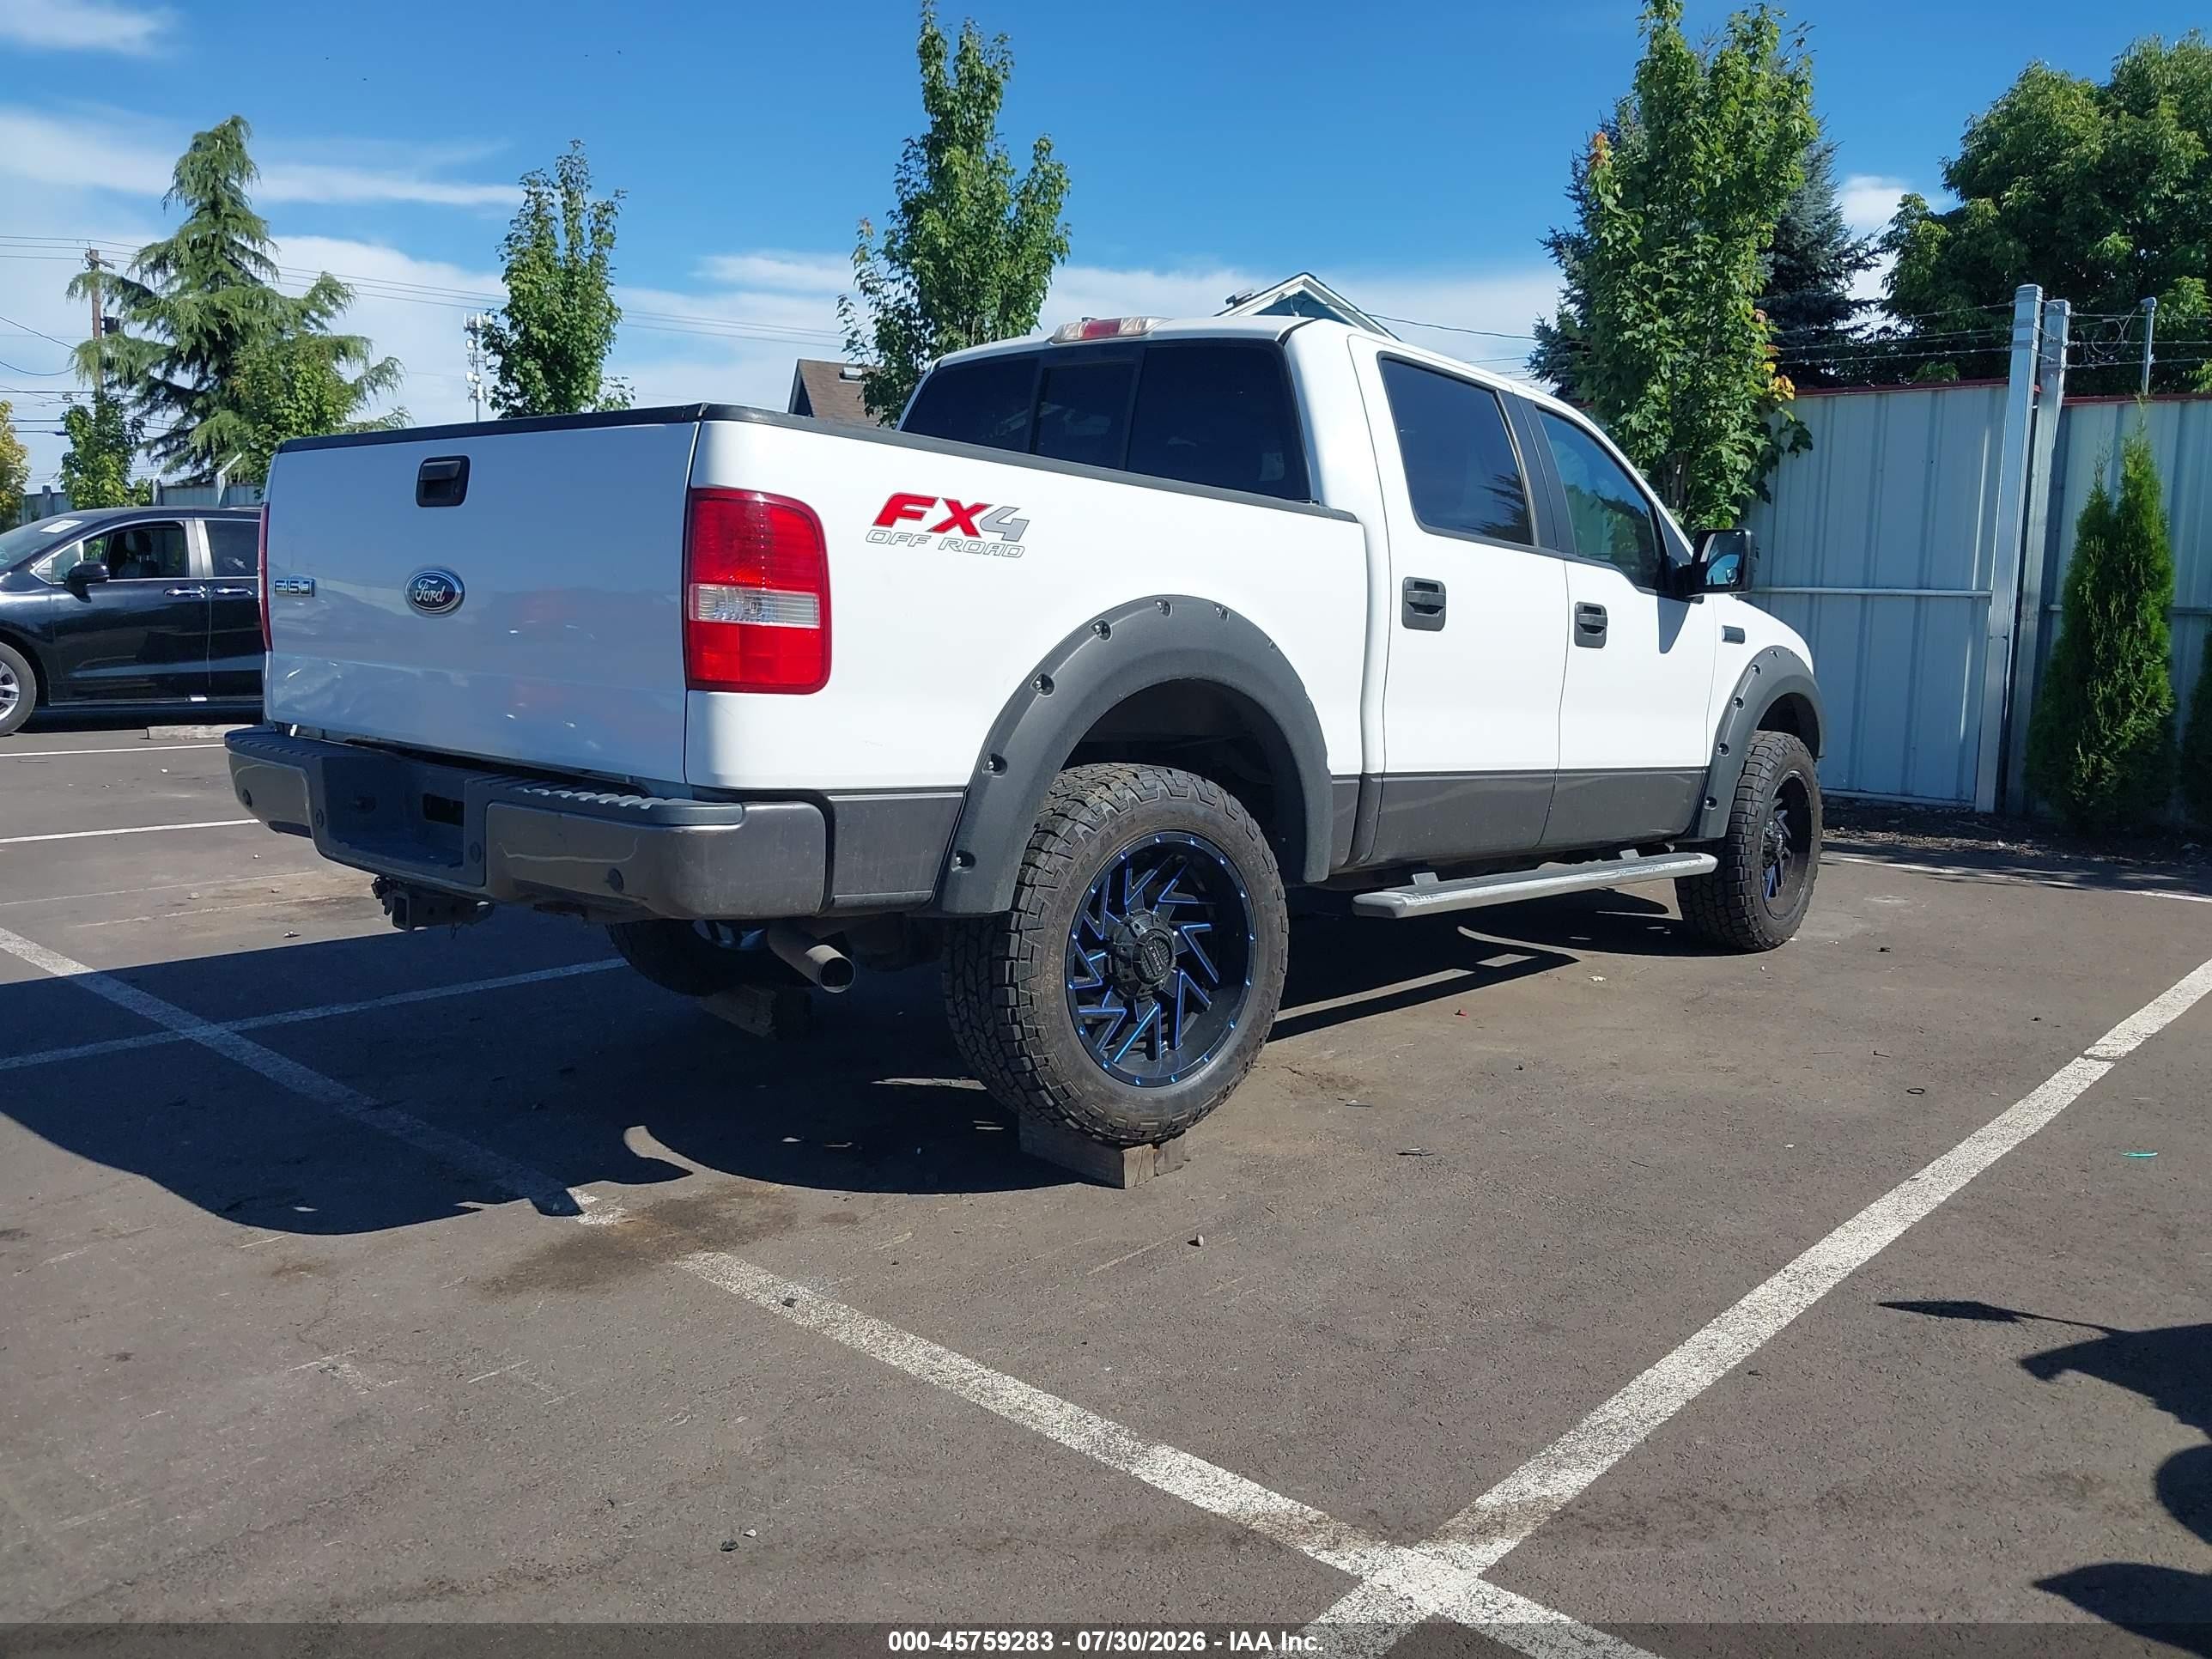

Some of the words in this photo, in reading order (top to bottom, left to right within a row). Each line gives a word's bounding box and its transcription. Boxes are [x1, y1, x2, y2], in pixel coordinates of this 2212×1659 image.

[872, 492, 1030, 543] FX4
[866, 529, 932, 547] OFF
[938, 538, 1024, 558] ROAD
[416, 578, 446, 603] Ford
